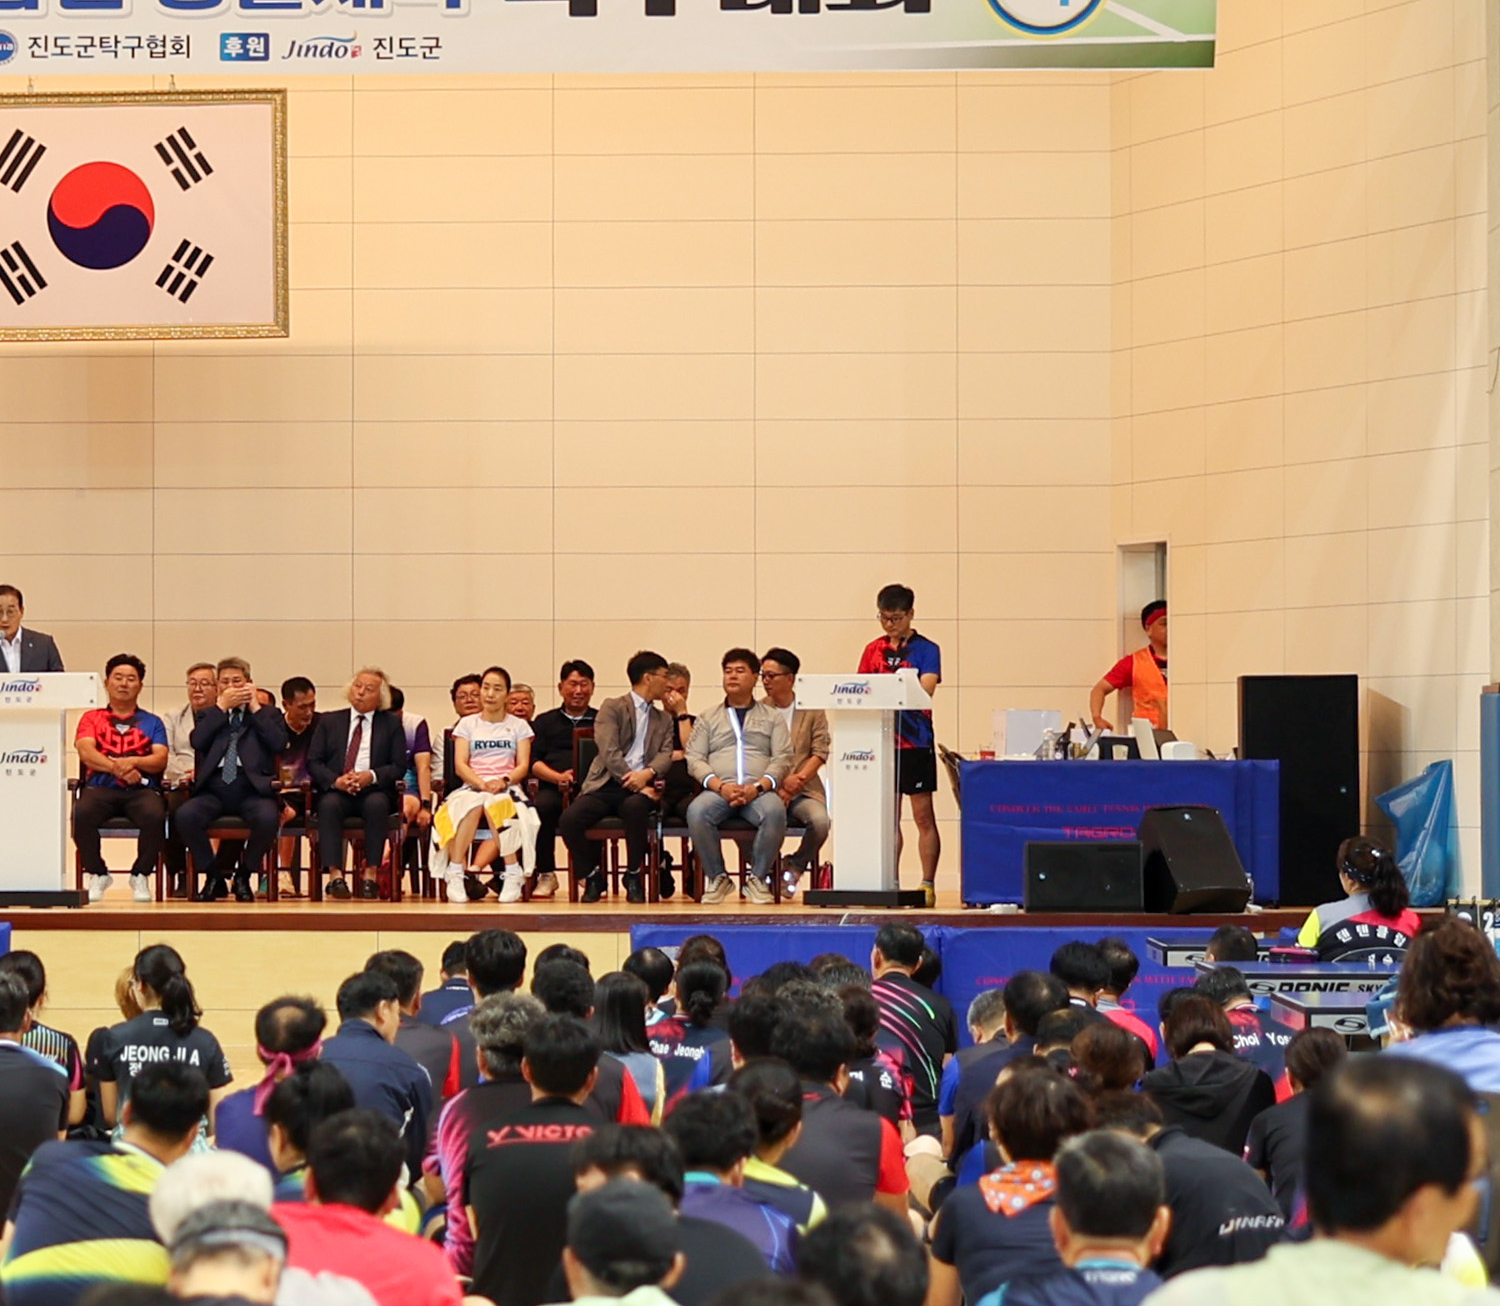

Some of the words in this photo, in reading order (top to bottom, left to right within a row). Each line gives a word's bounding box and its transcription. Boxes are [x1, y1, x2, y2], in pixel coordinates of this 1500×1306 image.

[27, 35, 192, 60] 진도군탁구협회
[223, 36, 267, 58] 후원
[282, 37, 351, 61] Jindo
[372, 36, 443, 60] 진도군
[474, 739, 512, 751] RYDER
[1278, 981, 1351, 993] DONIC
[120, 1044, 171, 1063] JEONG
